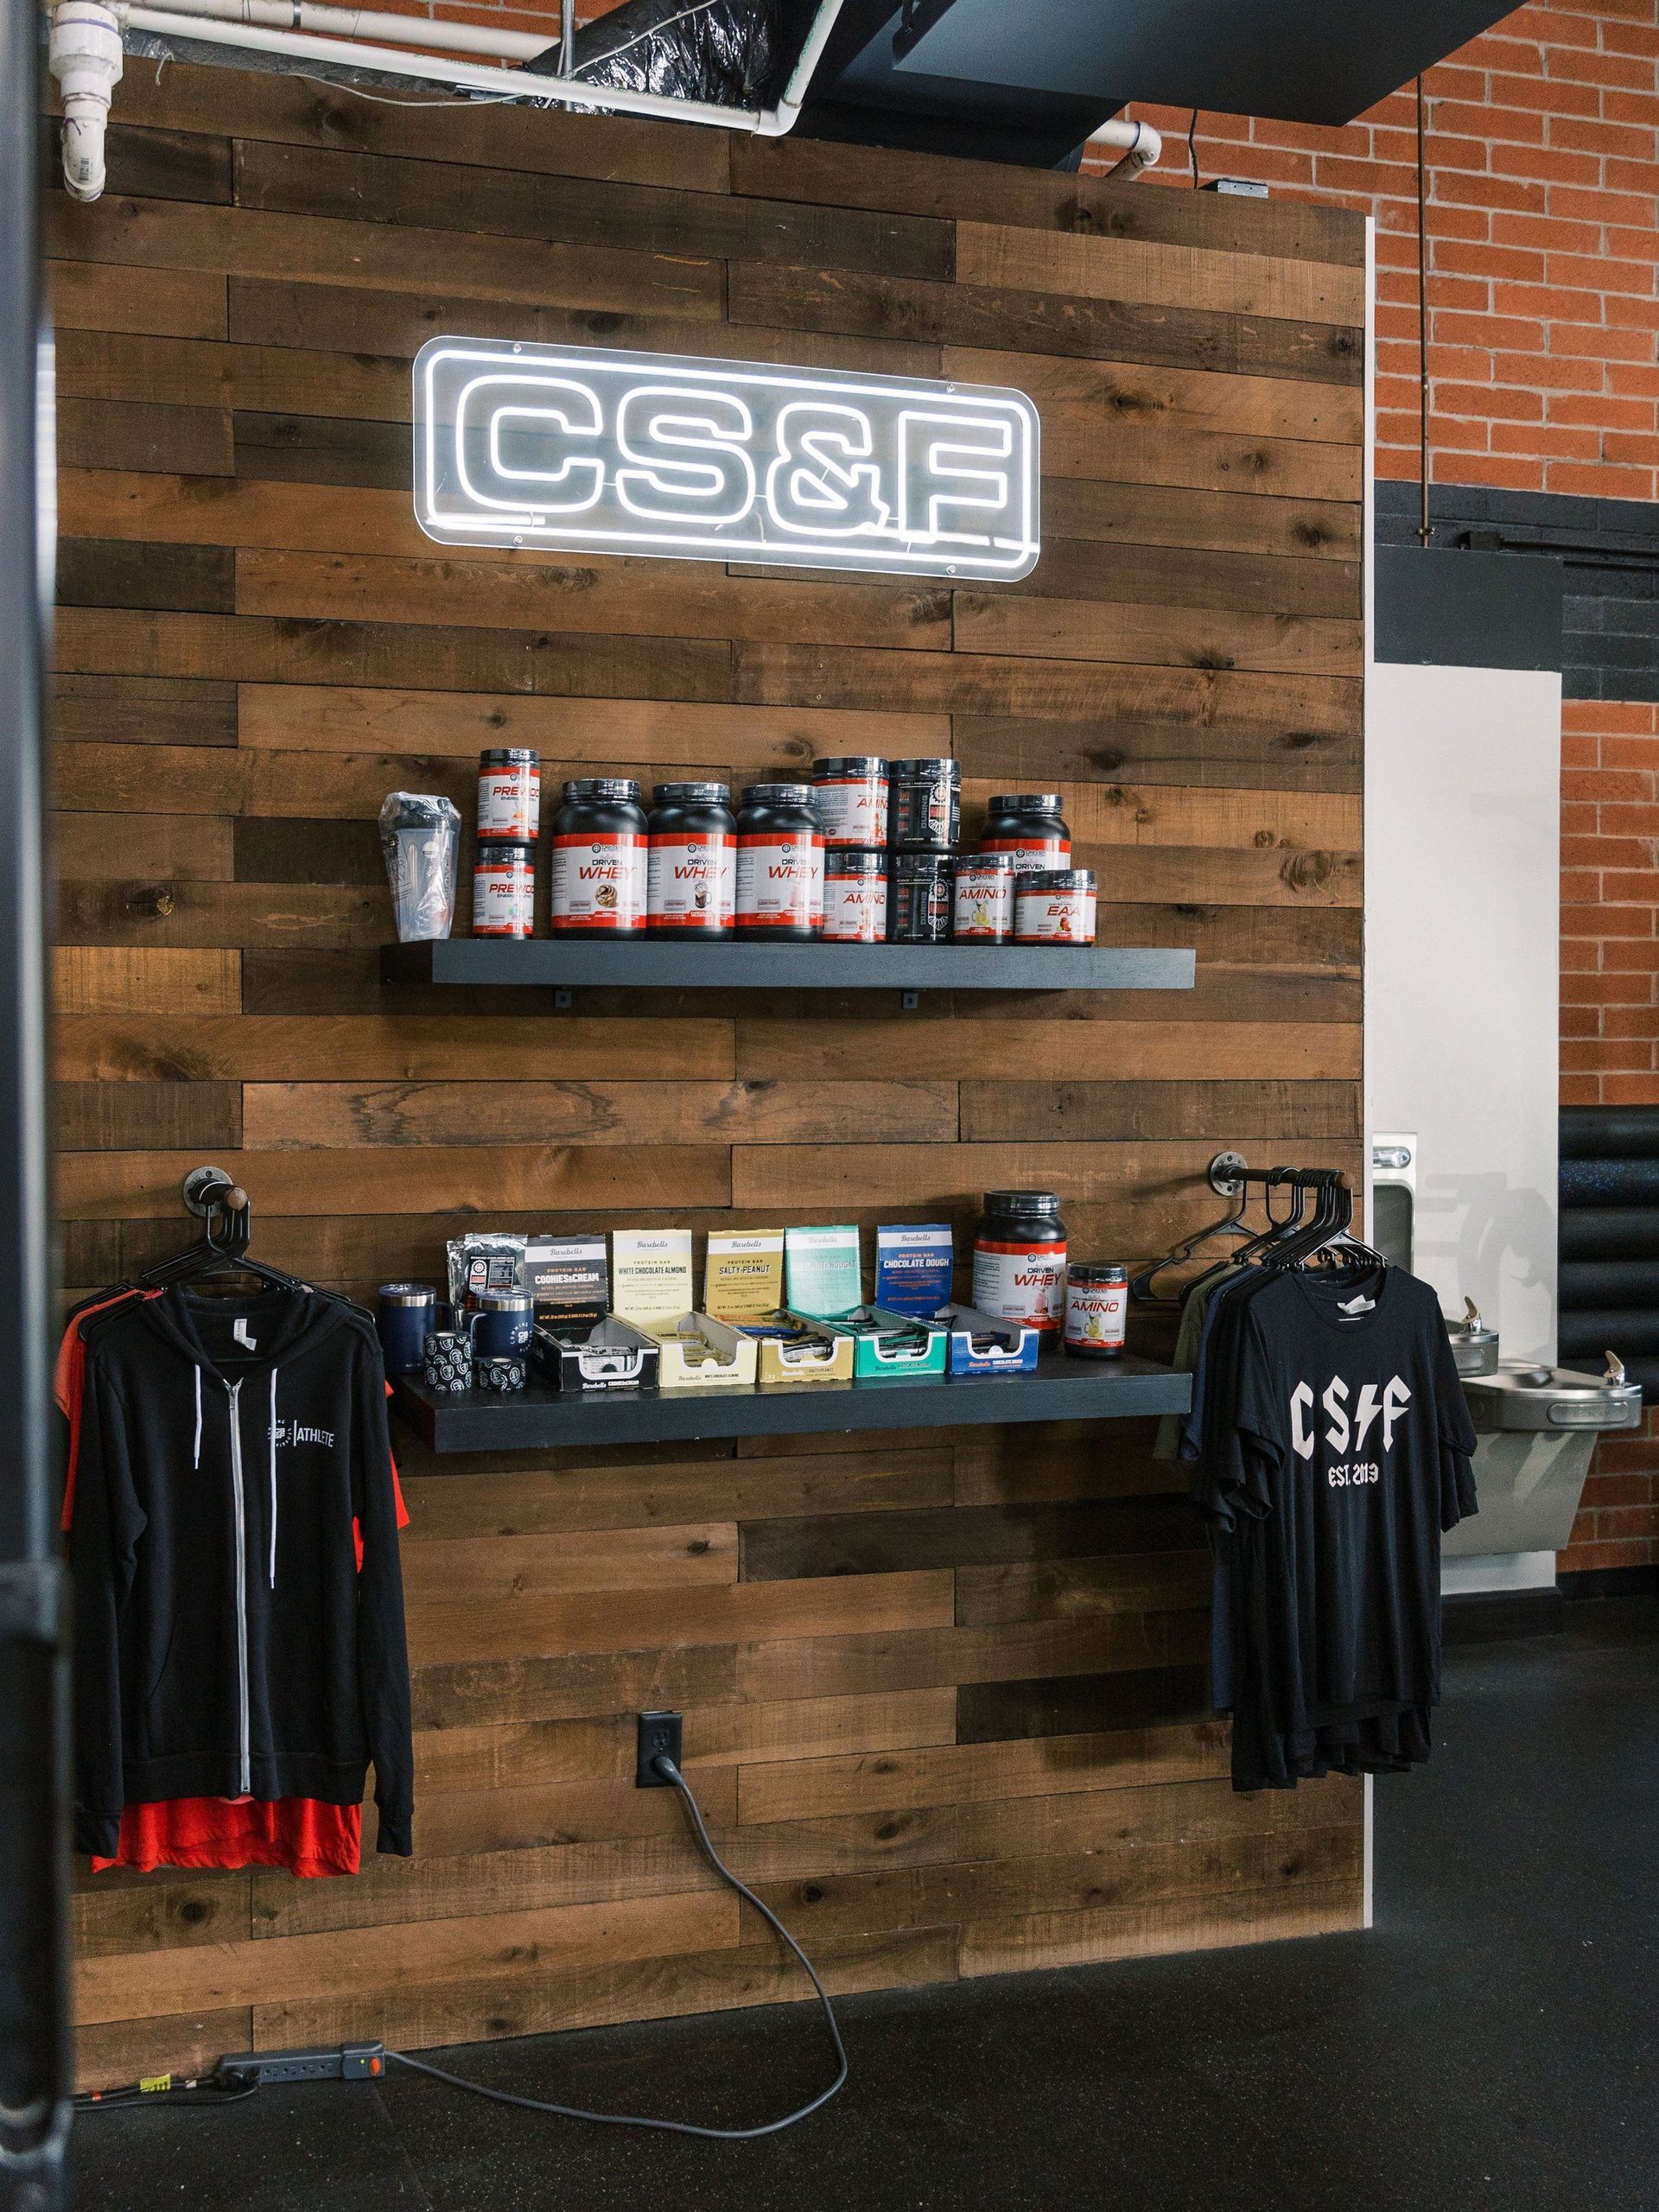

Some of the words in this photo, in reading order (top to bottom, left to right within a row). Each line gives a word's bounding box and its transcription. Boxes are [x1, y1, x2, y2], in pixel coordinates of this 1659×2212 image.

[455, 373, 1014, 544] CS&F
[579, 867, 635, 880] WHEY
[674, 866, 727, 879] WHEY
[768, 866, 818, 879] WHEY
[843, 893, 886, 905] AMINO
[959, 888, 1007, 899] AMINO
[1047, 906, 1080, 917] EAA
[731, 1240, 762, 1249] Barebells
[550, 1248, 582, 1256] Barebells
[884, 1259, 925, 1268] CHOCOLATE
[925, 1258, 950, 1268] DOUGH
[1014, 1272, 1063, 1286] WHEY
[1071, 1300, 1119, 1312] AMINO
[296, 1427, 334, 1448] ATHLETE
[1328, 1465, 1351, 1487] EST.
[1352, 1462, 1379, 1485] 2013
